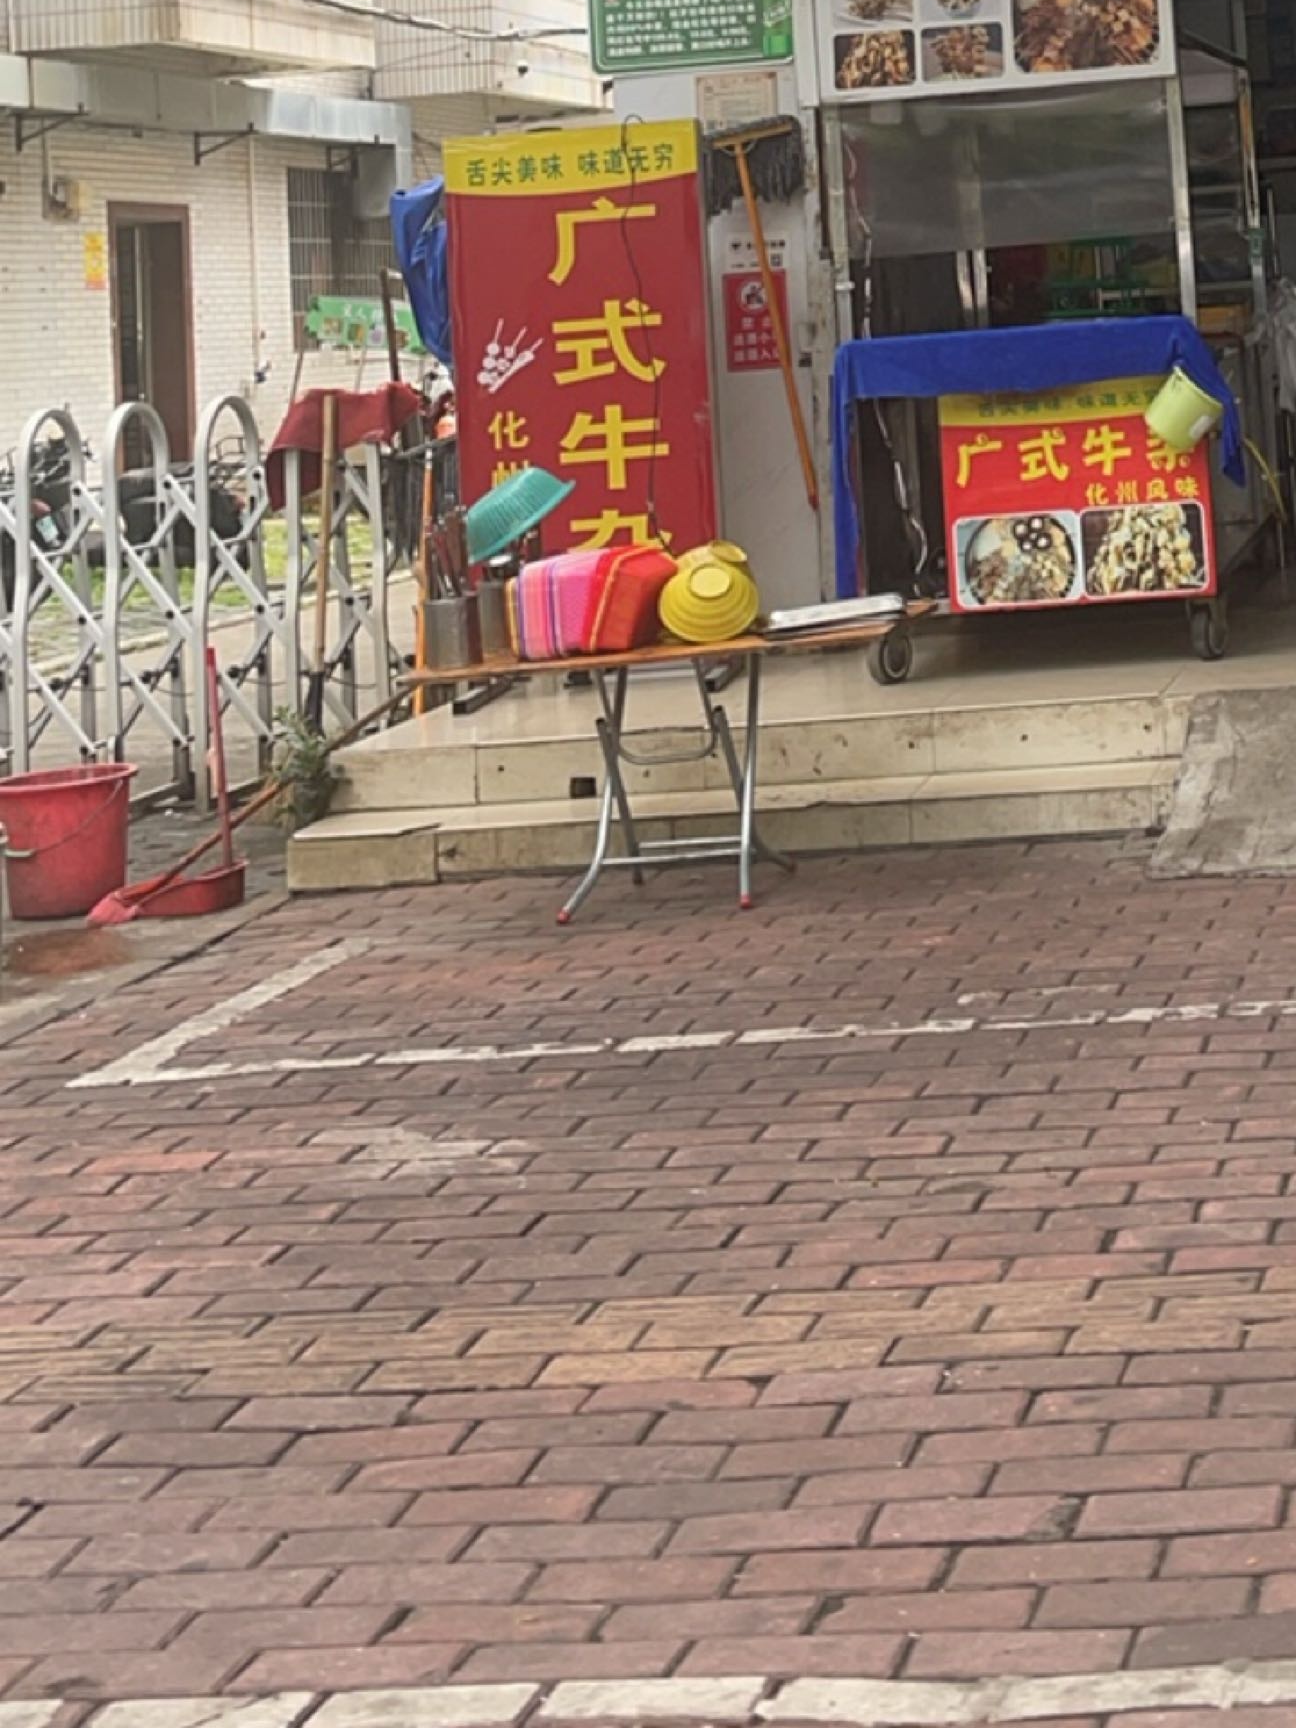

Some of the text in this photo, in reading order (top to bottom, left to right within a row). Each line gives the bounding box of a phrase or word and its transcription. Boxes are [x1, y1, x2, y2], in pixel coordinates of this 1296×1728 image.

[466, 143, 674, 186] 舌尖美味 味道无穷
[1085, 476, 1199, 505] 化州风味
